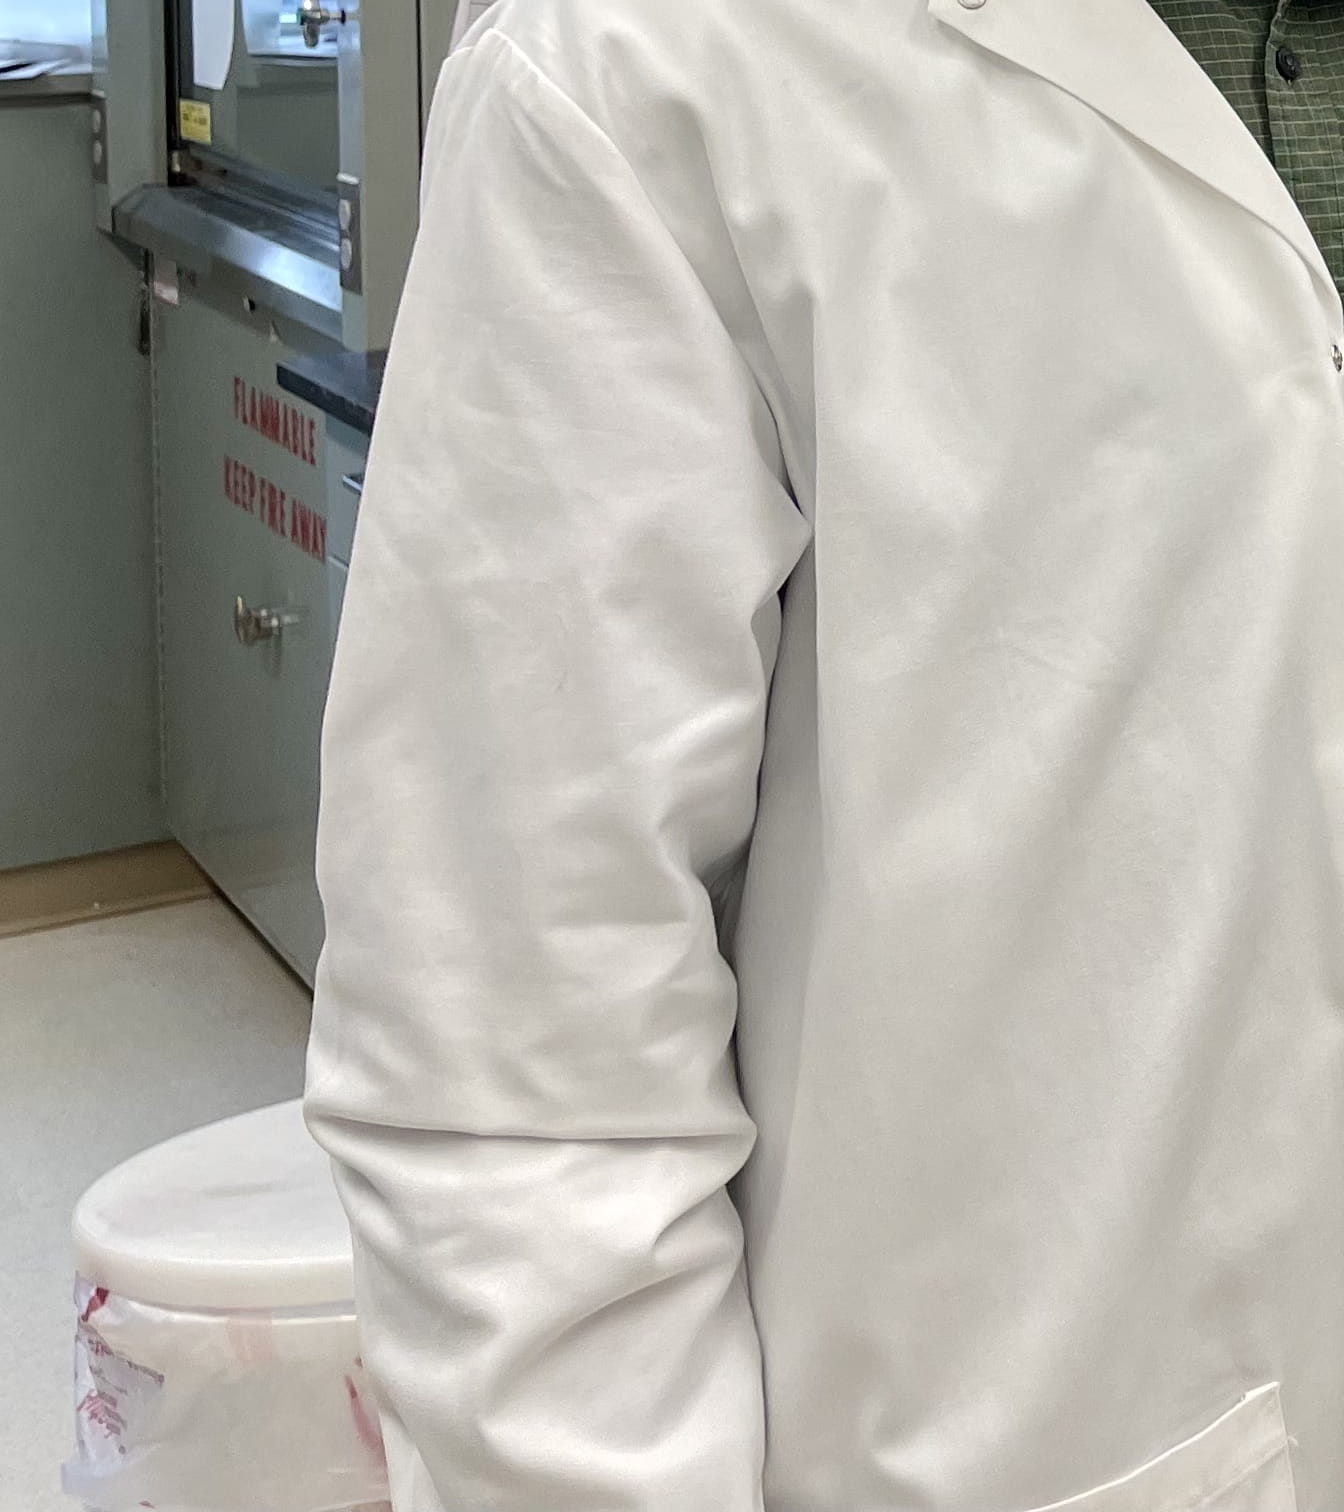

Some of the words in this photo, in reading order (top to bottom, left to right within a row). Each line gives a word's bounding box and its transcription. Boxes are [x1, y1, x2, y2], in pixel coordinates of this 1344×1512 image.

[234, 376, 315, 466] FLAMMABLE
[224, 452, 256, 515] KEEP
[259, 476, 287, 538] FIRE
[291, 498, 328, 565] AWAY
